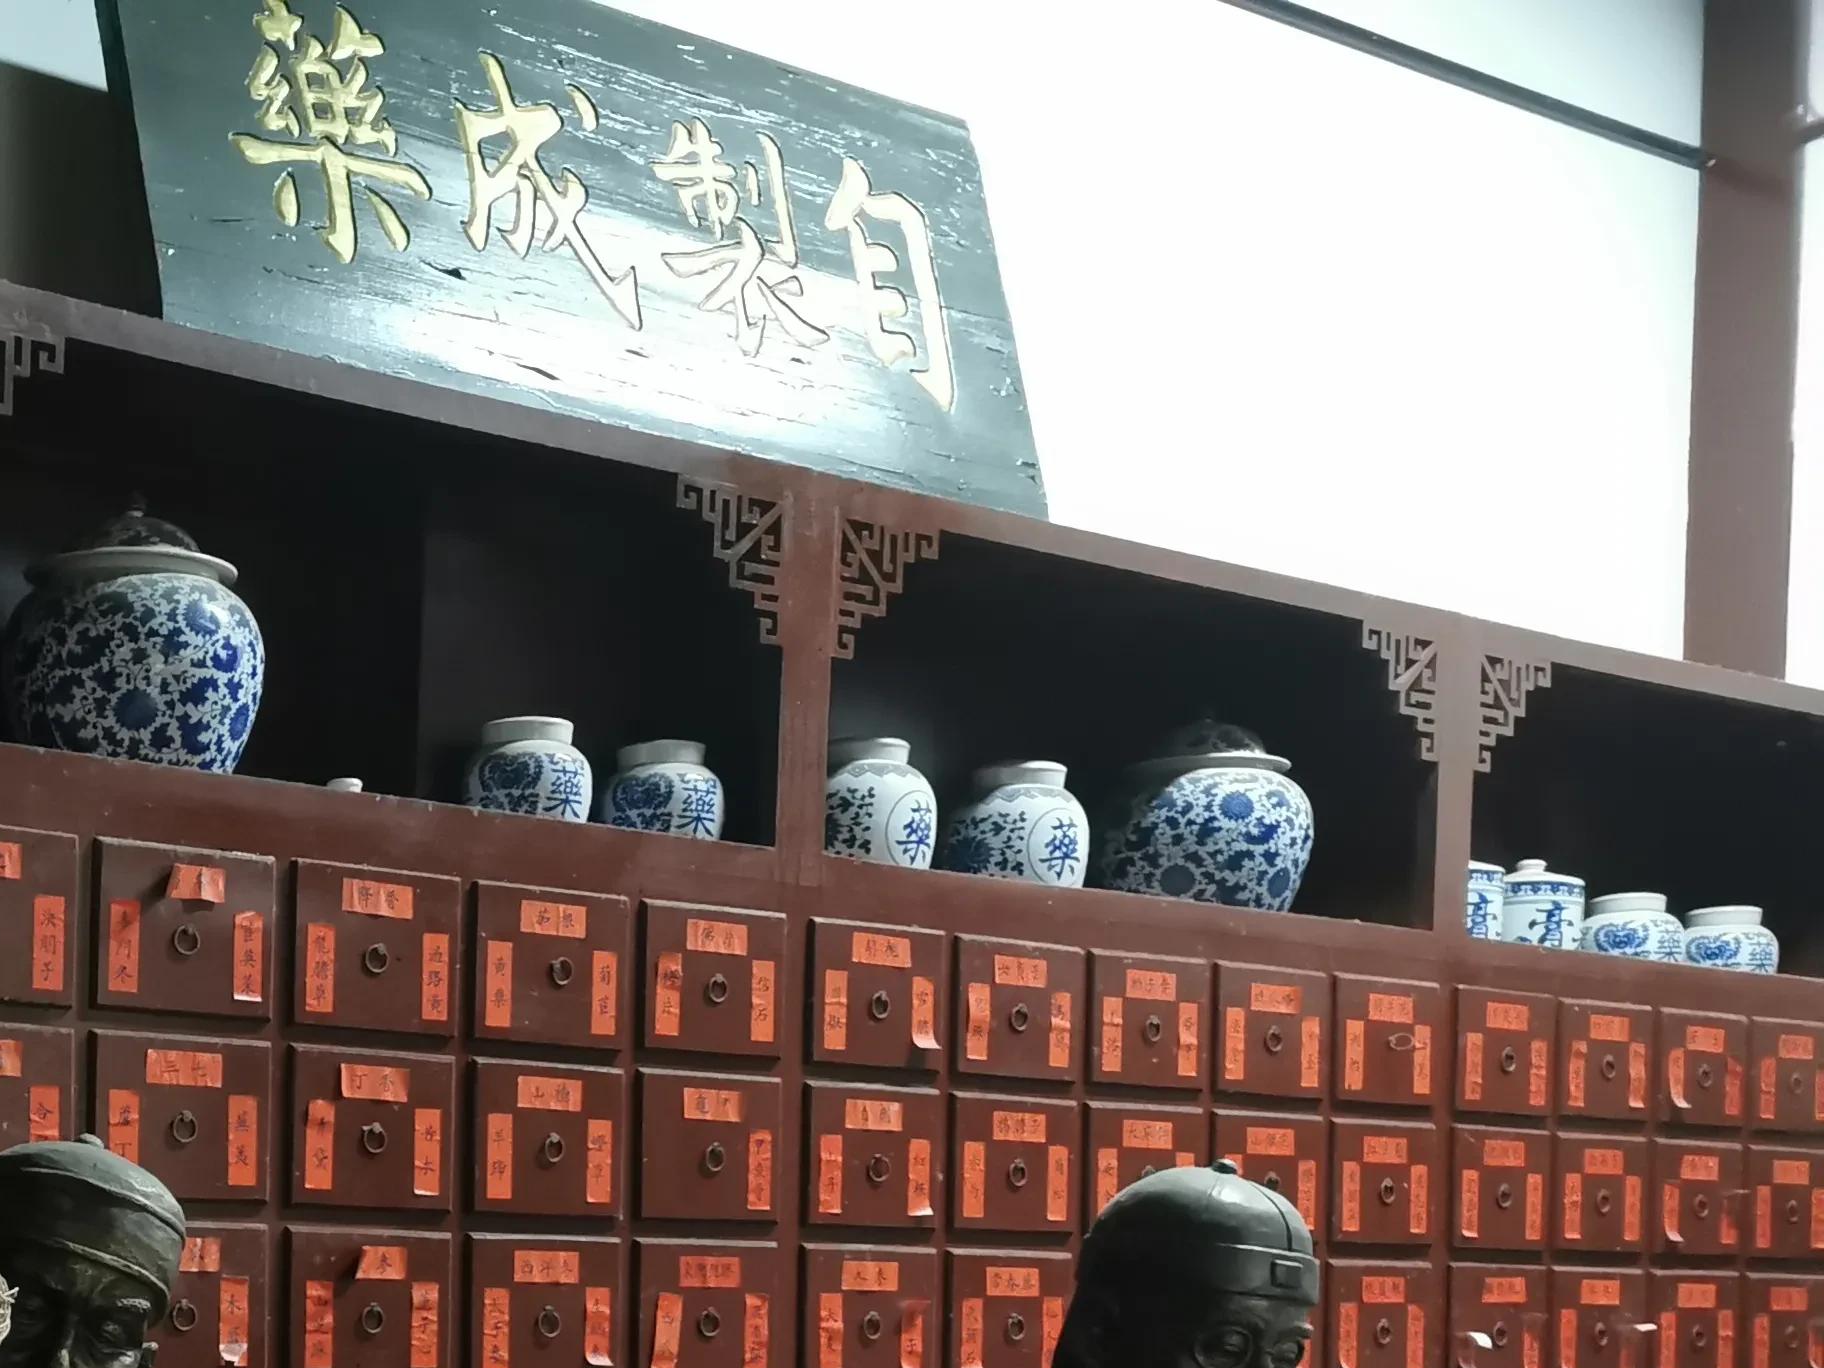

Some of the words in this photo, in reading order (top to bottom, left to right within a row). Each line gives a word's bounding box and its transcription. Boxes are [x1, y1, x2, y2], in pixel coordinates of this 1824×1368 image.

[545, 763, 583, 819] 藥
[677, 775, 717, 838] 藥
[896, 801, 935, 865] 藥
[1044, 817, 1082, 880] 藥
